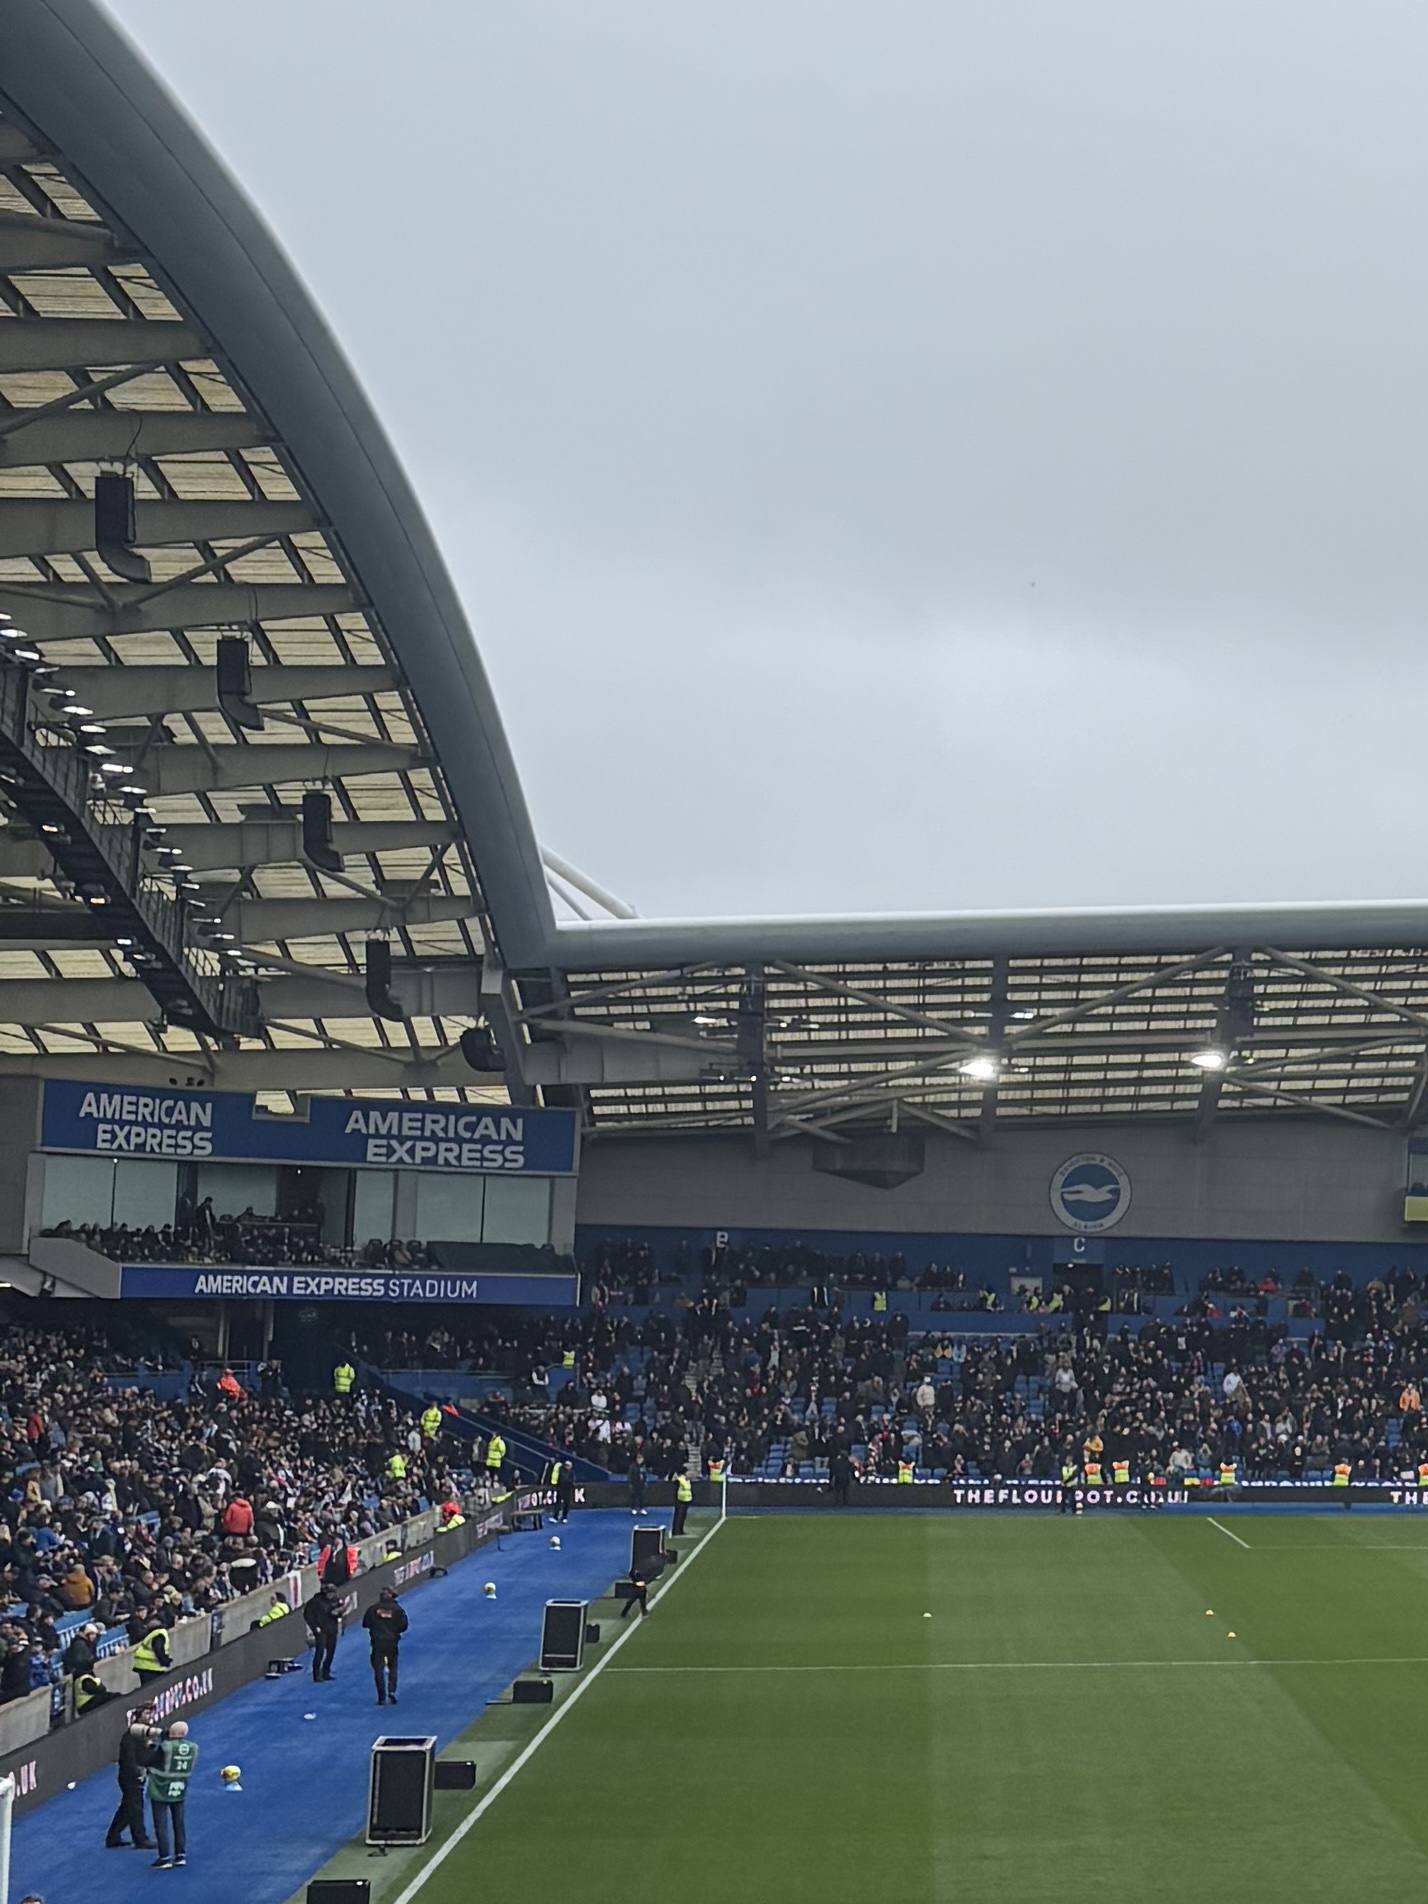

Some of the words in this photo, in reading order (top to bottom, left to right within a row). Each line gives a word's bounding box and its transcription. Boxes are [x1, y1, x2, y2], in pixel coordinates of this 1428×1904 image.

[79, 1092, 213, 1127] AMERICAN
[96, 1123, 213, 1156] EXPRESS
[345, 1110, 524, 1142] AMERICAN
[366, 1139, 525, 1169] EXPRESS
[1073, 1237, 1086, 1252] C
[194, 1274, 288, 1295] AMERICAN
[292, 1276, 385, 1297] EXPRESS
[388, 1278, 478, 1299] STADIUM
